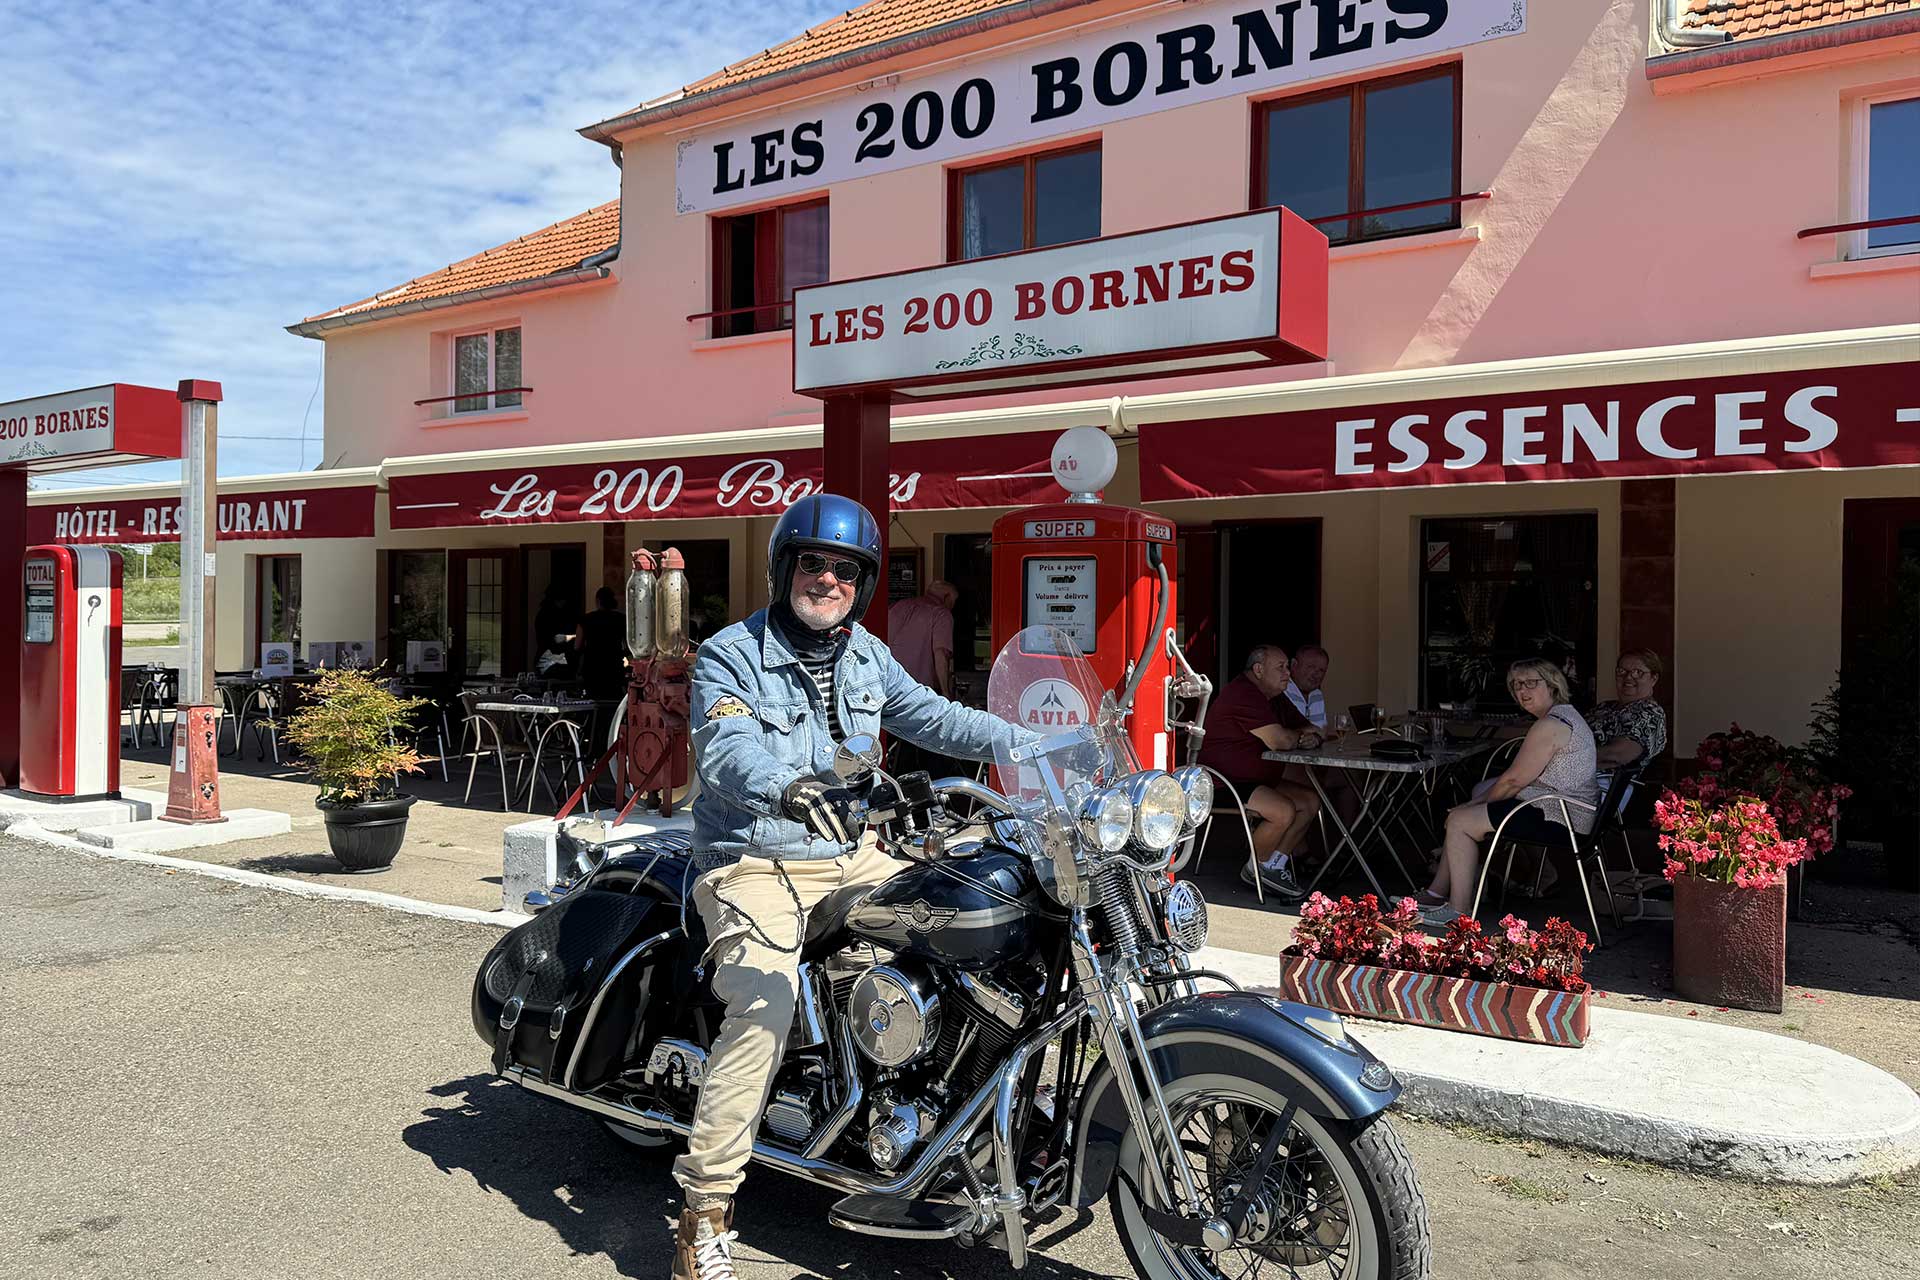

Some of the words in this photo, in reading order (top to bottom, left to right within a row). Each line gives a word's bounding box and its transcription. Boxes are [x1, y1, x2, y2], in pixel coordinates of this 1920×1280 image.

[714, 118, 825, 196] LES
[855, 77, 997, 164] 200
[1031, 0, 1450, 124] BORNES
[809, 304, 885, 347] LES
[903, 288, 993, 335] 200
[1014, 249, 1256, 322] BORNES
[0, 416, 28, 440] 200
[34, 405, 109, 436] BORNES
[1334, 385, 1839, 476] ESSENCES
[479, 474, 558, 519] Les
[578, 465, 684, 515] 200
[716, 458, 922, 508] Boes
[55, 505, 120, 538] HÔTEL
[142, 499, 307, 535] RESURANT
[1035, 522, 1085, 537] SUPER
[1147, 523, 1167, 538] SUPER
[27, 565, 54, 581] TOTAL
[1064, 563, 1086, 572] payer
[1027, 709, 1081, 726] AVIA
